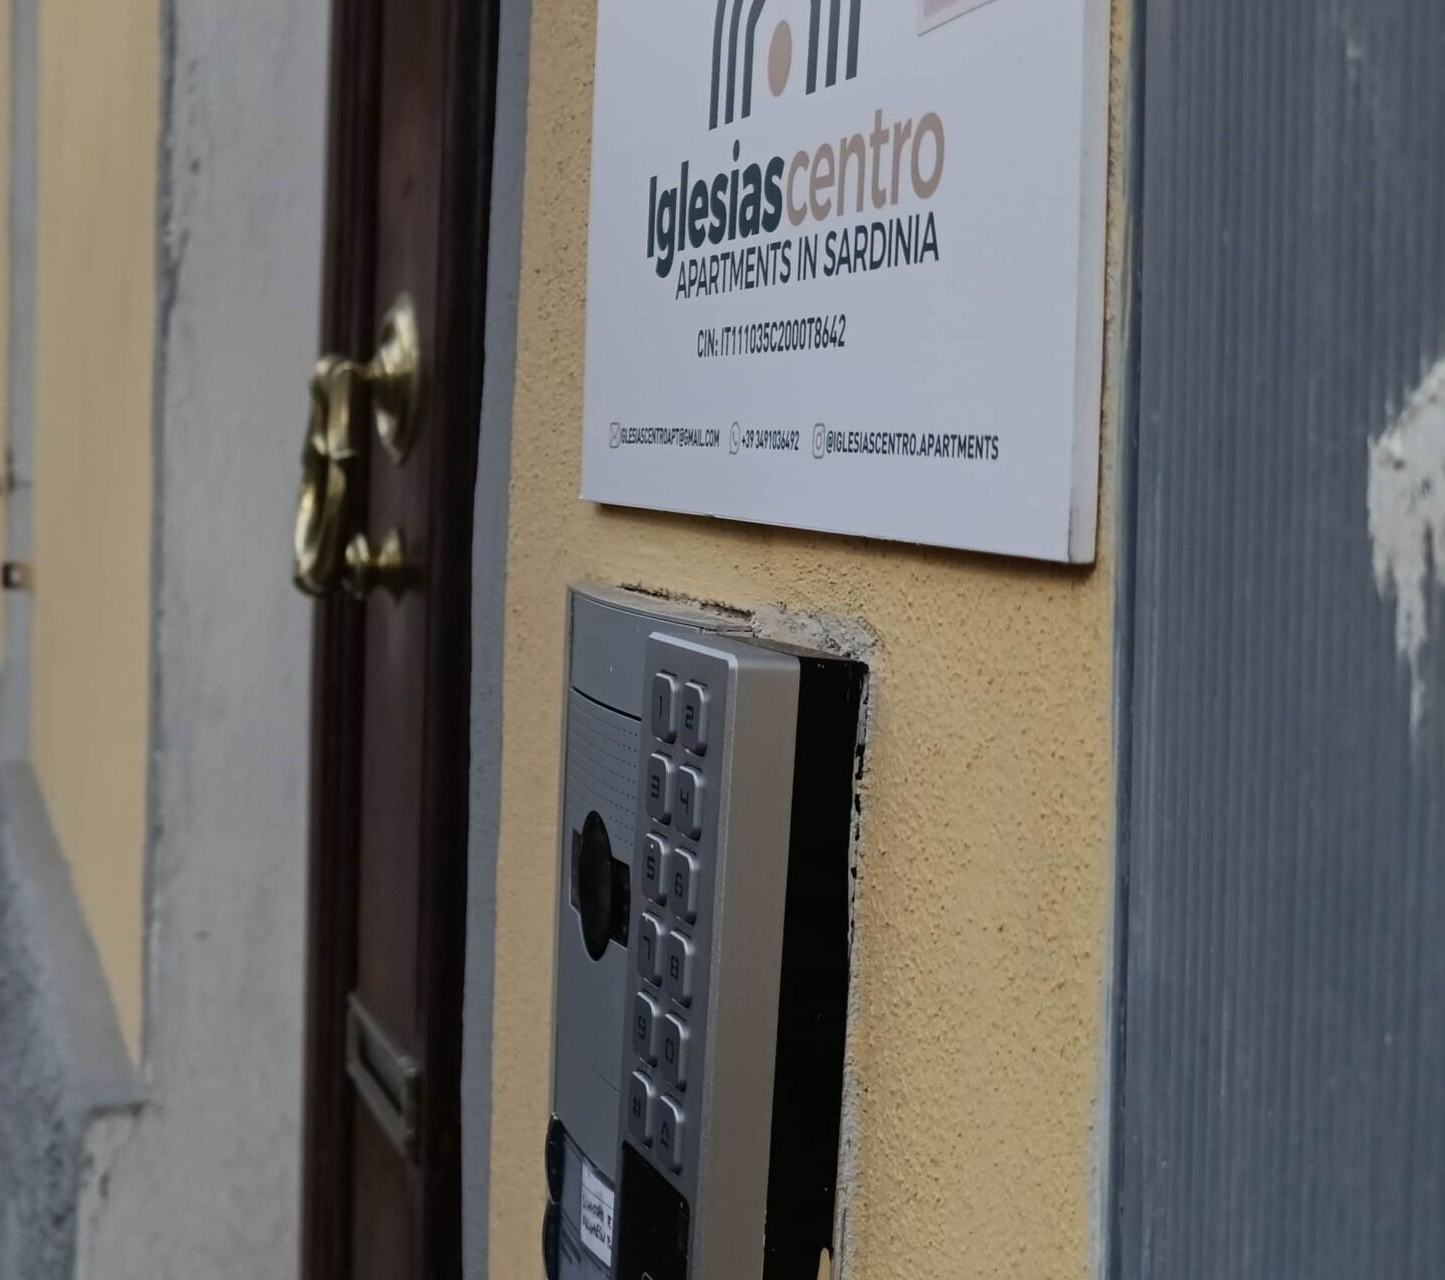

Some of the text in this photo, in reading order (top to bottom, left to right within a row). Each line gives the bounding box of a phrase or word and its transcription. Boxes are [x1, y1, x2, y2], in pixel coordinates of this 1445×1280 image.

[647, 108, 945, 278] Iglesiascentro
[675, 211, 939, 300] APARTMENTS IN SARDINIA
[697, 313, 847, 358] CIN: IT111035C2000T8642
[741, 429, 800, 451] +39 3491036492
[825, 429, 999, 461] @IGLESIASCENTRO.APARTMENTS
